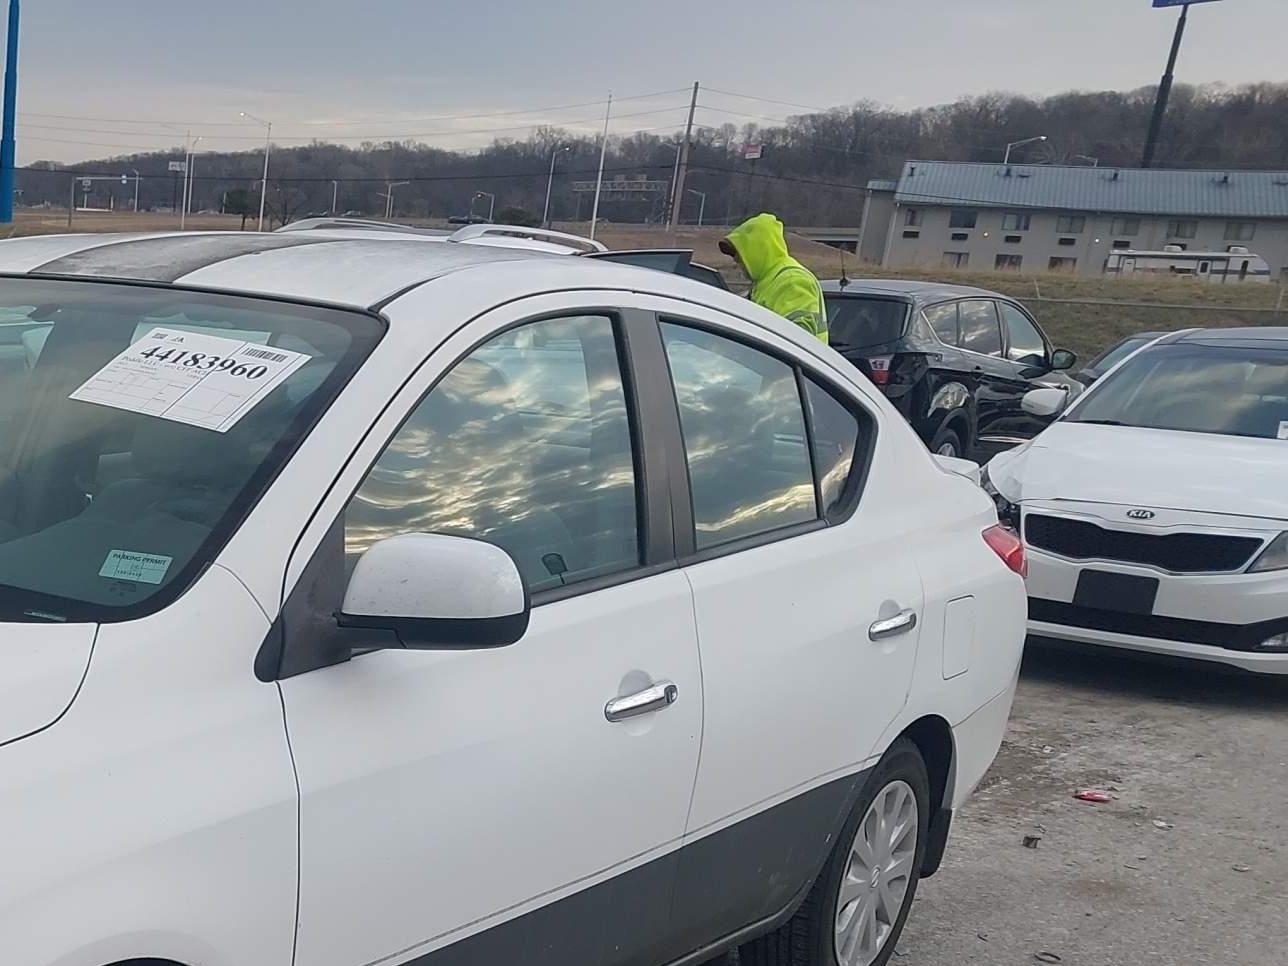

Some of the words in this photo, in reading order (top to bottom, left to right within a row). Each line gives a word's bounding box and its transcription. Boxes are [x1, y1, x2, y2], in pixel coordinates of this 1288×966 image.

[139, 346, 269, 379] 44183960
[1128, 509, 1152, 519] KIA
[112, 553, 141, 562] PARKING
[141, 557, 167, 566] PERMIT
